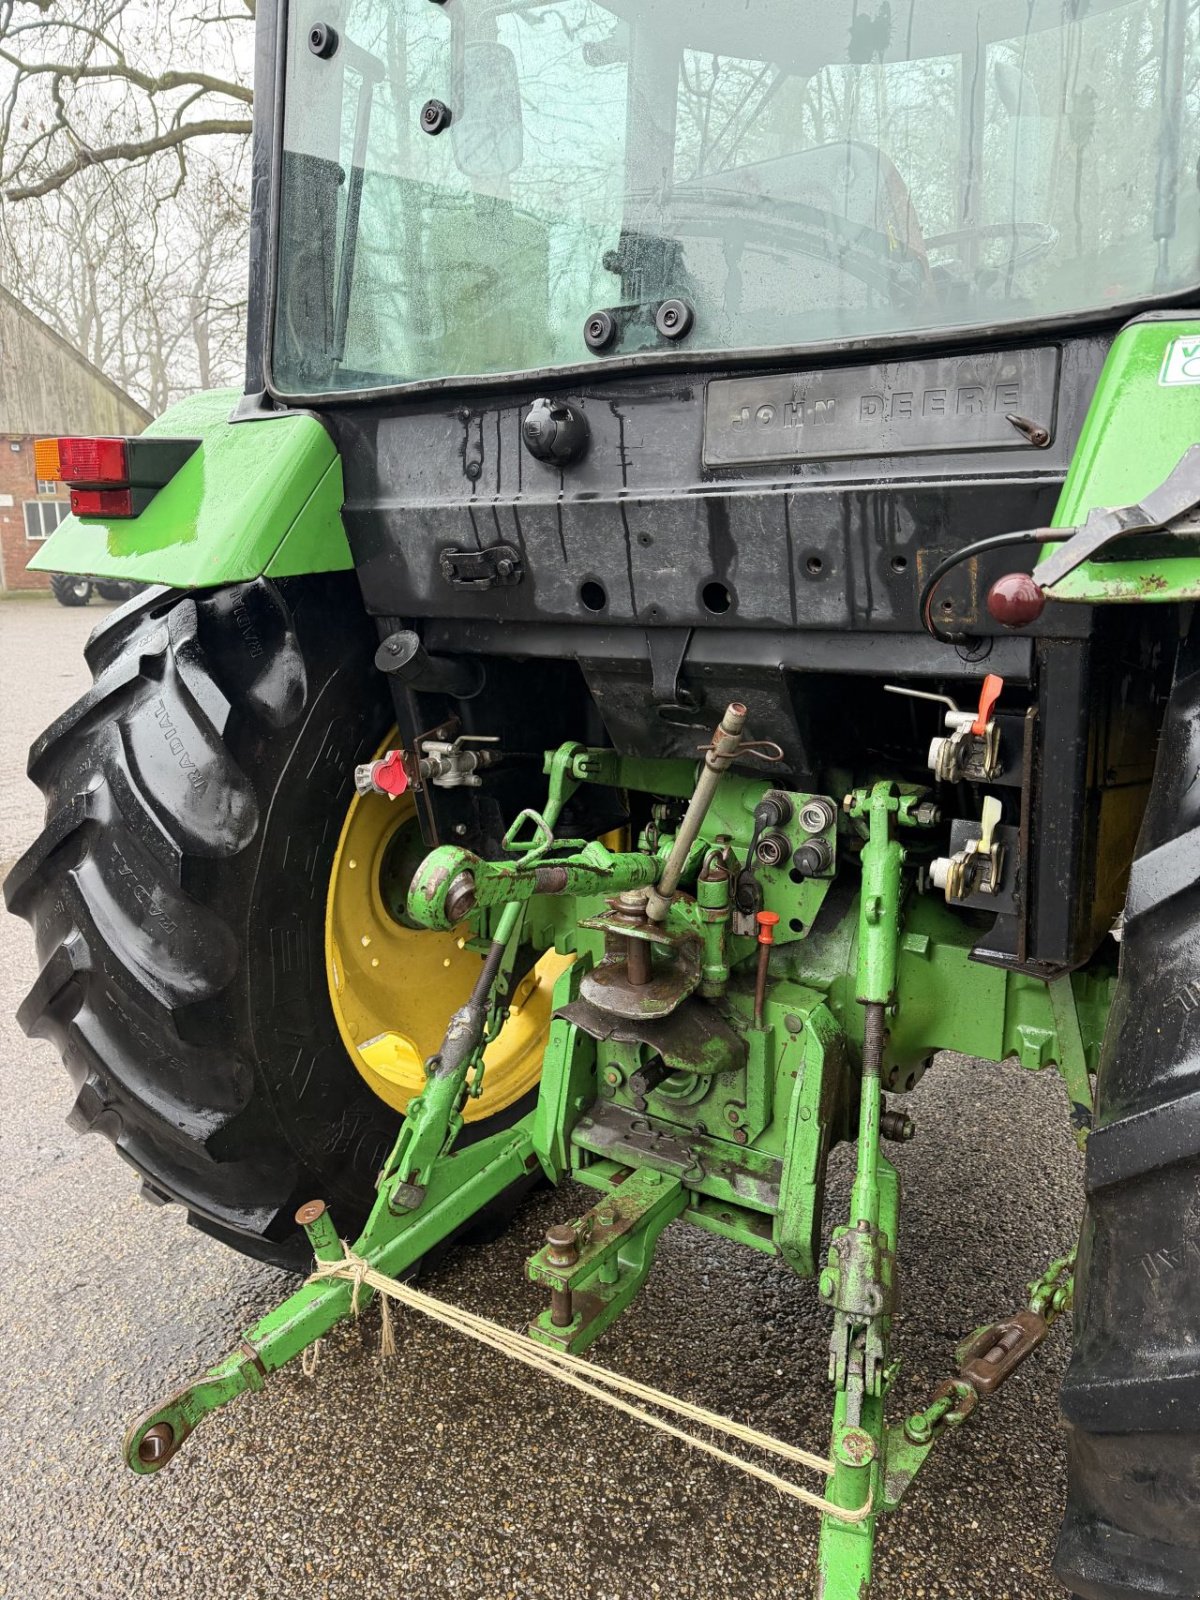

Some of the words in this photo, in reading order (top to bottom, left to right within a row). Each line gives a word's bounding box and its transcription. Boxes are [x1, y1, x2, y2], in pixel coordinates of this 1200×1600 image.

[731, 399, 836, 433] JOHN
[860, 383, 1020, 422] DEERE
[152, 698, 208, 788] RADIAL
